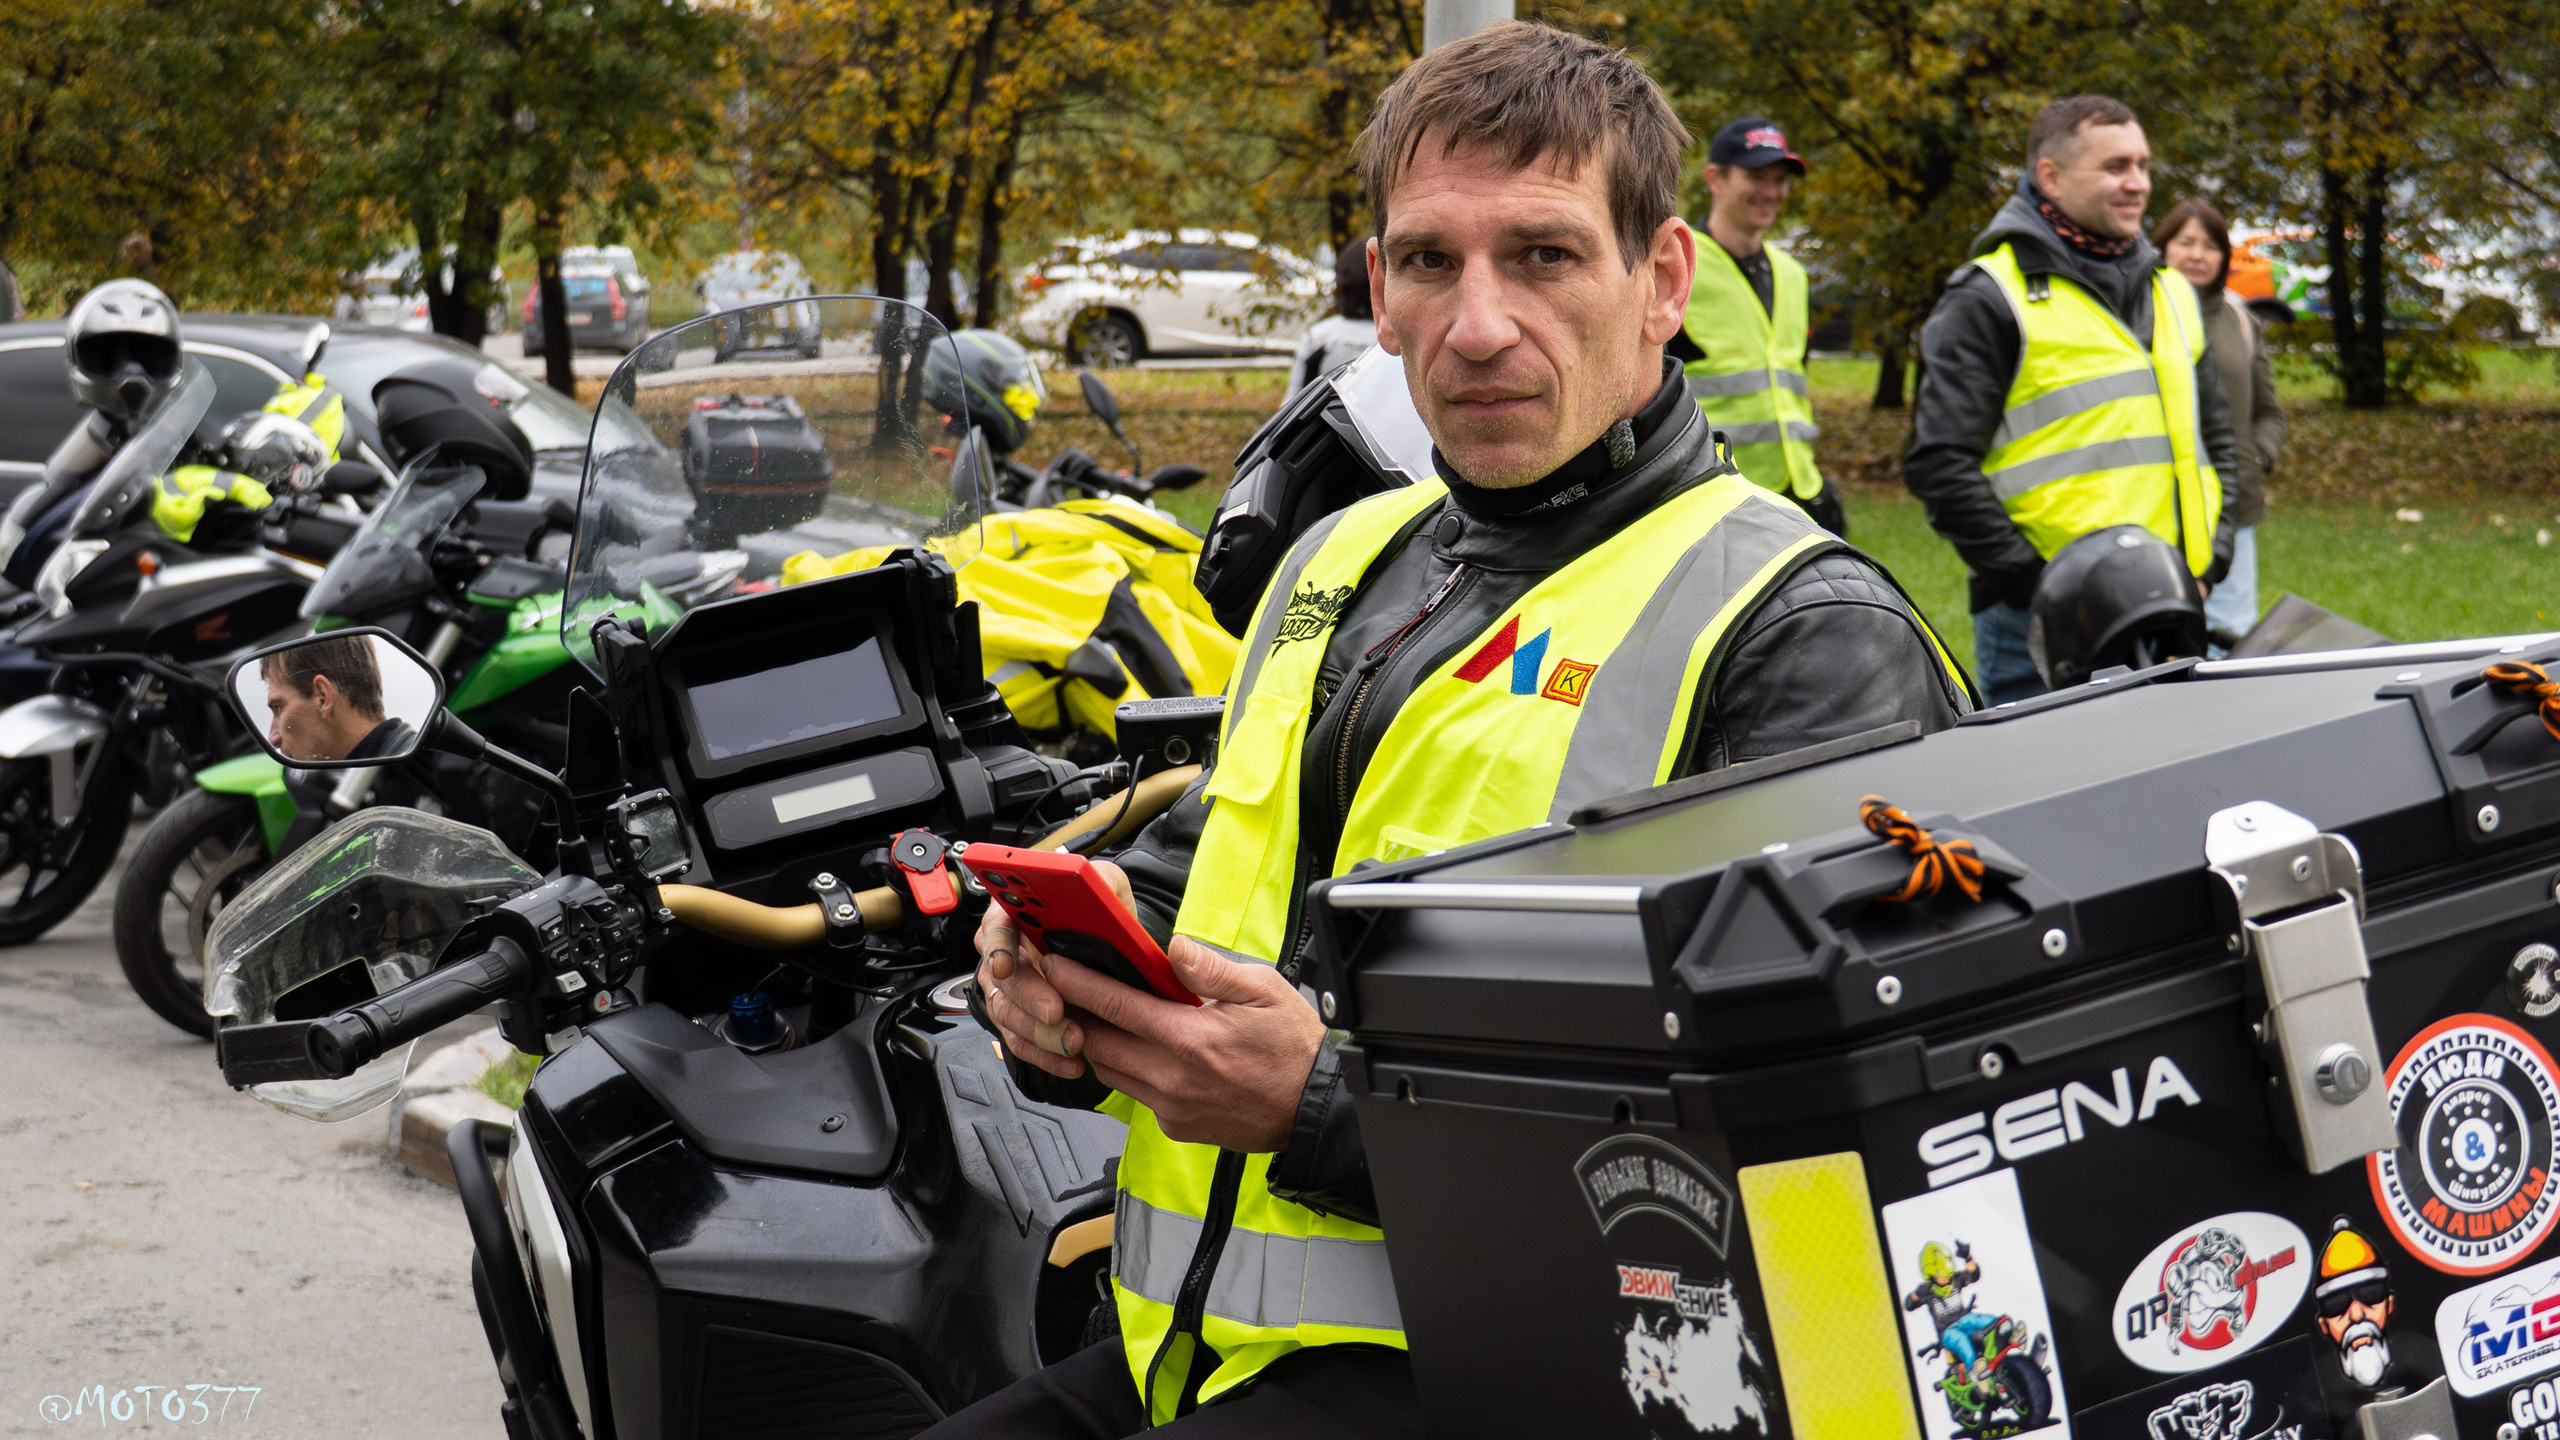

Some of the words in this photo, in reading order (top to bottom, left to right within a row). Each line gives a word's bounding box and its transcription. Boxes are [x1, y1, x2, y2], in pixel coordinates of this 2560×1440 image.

[1559, 670, 1584, 692] K
[2420, 1051, 2505, 1098] ЛЮДИ
[1918, 1056, 2202, 1189] SENA
[2442, 1090, 2491, 1117] Андрей
[2465, 1131, 2486, 1161] &
[2421, 1166, 2548, 1238] МАШИНЫ
[2448, 1166, 2513, 1202] Шипулин
[2127, 1291, 2169, 1342] QP
[2511, 1376, 2560, 1430] GO
[2534, 1420, 2560, 1440] TR
